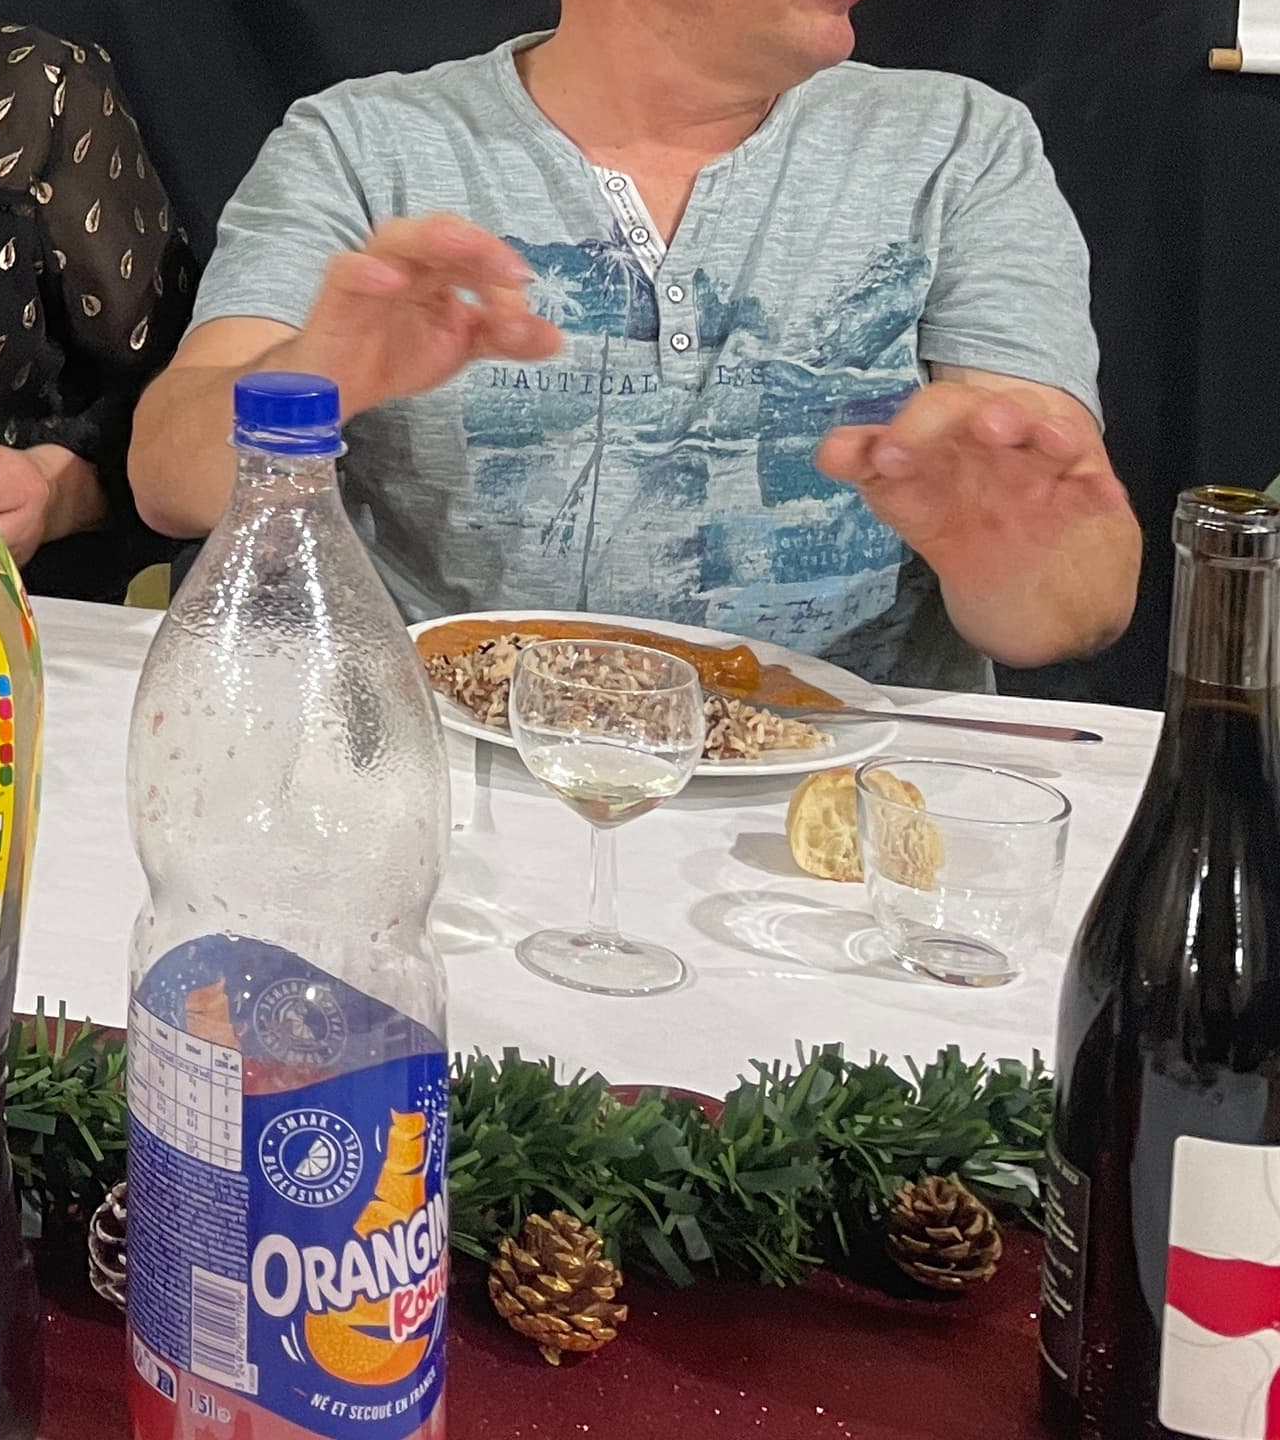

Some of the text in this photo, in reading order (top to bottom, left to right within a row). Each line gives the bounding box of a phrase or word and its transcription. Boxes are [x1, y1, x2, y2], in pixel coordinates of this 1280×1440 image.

[490, 366, 659, 396] NAUTICAL
[276, 1113, 329, 1135] SMAAK
[251, 1193, 448, 1318] ORANGIN
[394, 1265, 447, 1338] Rou
[310, 1392, 330, 1411] NÉ
[330, 1400, 347, 1417] ET
[348, 1400, 393, 1421] SECOUÉ
[395, 1398, 409, 1414] EN
